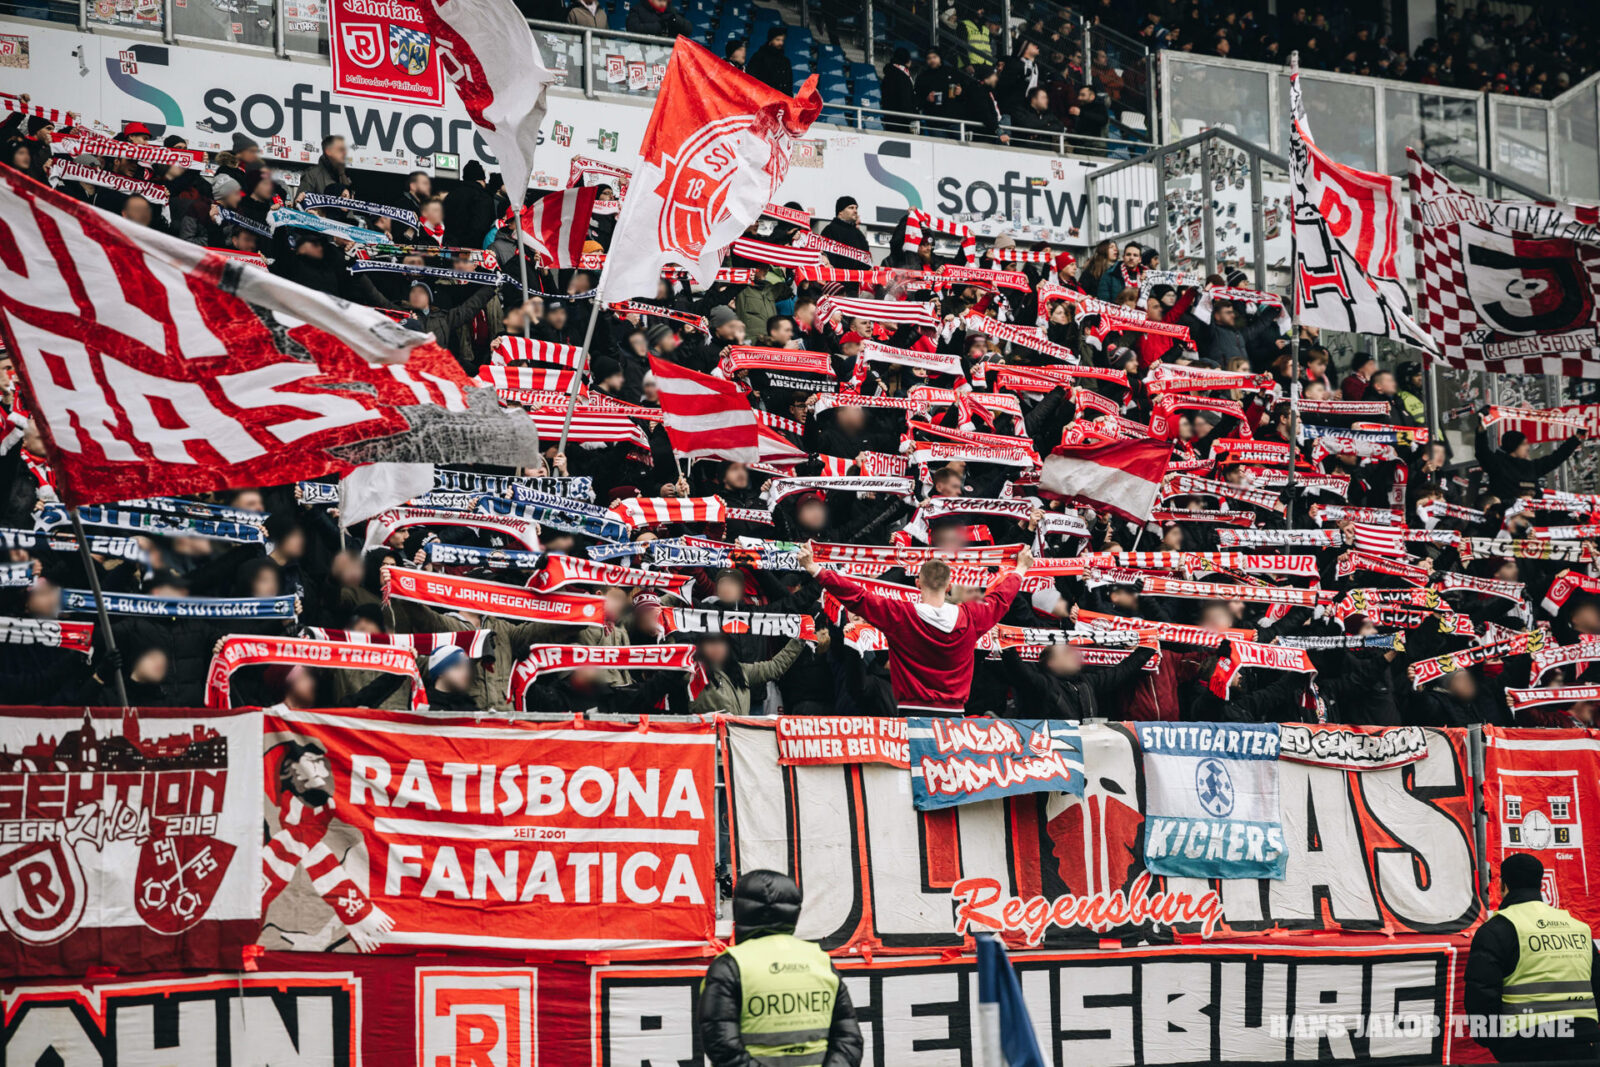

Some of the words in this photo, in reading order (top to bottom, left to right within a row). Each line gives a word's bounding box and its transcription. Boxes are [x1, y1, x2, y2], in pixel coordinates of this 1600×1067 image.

[685, 178, 706, 199] 18
[1486, 332, 1597, 359] REGENSBURG
[770, 379, 836, 392] ABSCHAFFEN
[931, 389, 955, 401] JAHN
[1150, 380, 1166, 392] SSV
[1169, 378, 1190, 390] Jahn
[1191, 376, 1244, 388] Regensburg
[931, 442, 962, 459] Gegen
[1232, 443, 1252, 451] JAHN
[1254, 444, 1290, 452] REGENSBU
[1239, 451, 1291, 462] JAHNELF
[304, 483, 339, 500] BLA
[1179, 476, 1216, 493] SSV
[942, 497, 1032, 517] REGENSBURG
[378, 509, 400, 529] SSV
[404, 508, 436, 519] JAHN
[458, 511, 531, 534] REGENSBURG
[1247, 554, 1313, 572] NSBUR
[427, 582, 453, 597] SSV
[455, 588, 489, 604] JAHN
[491, 593, 572, 615] REGENSBURG
[1165, 580, 1212, 595] SSV
[1244, 586, 1304, 604] JAHN
[177, 601, 261, 616] STUTTGART
[275, 642, 332, 661] JAKOB
[338, 648, 415, 670] TRIBÜNE
[517, 648, 563, 681] NUR
[573, 647, 620, 664] DER
[628, 648, 676, 663] SSV
[1236, 641, 1304, 669] ULTRAS
[779, 717, 876, 738] CHRISTOPH
[879, 717, 909, 740] FÜR
[781, 738, 844, 759] IMMER
[847, 737, 877, 756] BEI
[880, 740, 911, 763] UNS
[1142, 726, 1279, 757] STUTTGARTER
[1311, 726, 1427, 762] GENERATION
[349, 754, 705, 820] RATISBONA
[165, 814, 218, 837] 2019
[513, 826, 537, 840] SEIT
[539, 829, 566, 840] 2001
[1146, 818, 1284, 863] KICKERS
[384, 842, 705, 905] FANATICA
[951, 871, 1223, 947] Regensburg
[1528, 934, 1588, 953] ORDNER
[609, 959, 1438, 1065] RENSBURG
[747, 990, 831, 1017] ORDNER
[3, 994, 336, 1067] AHN
